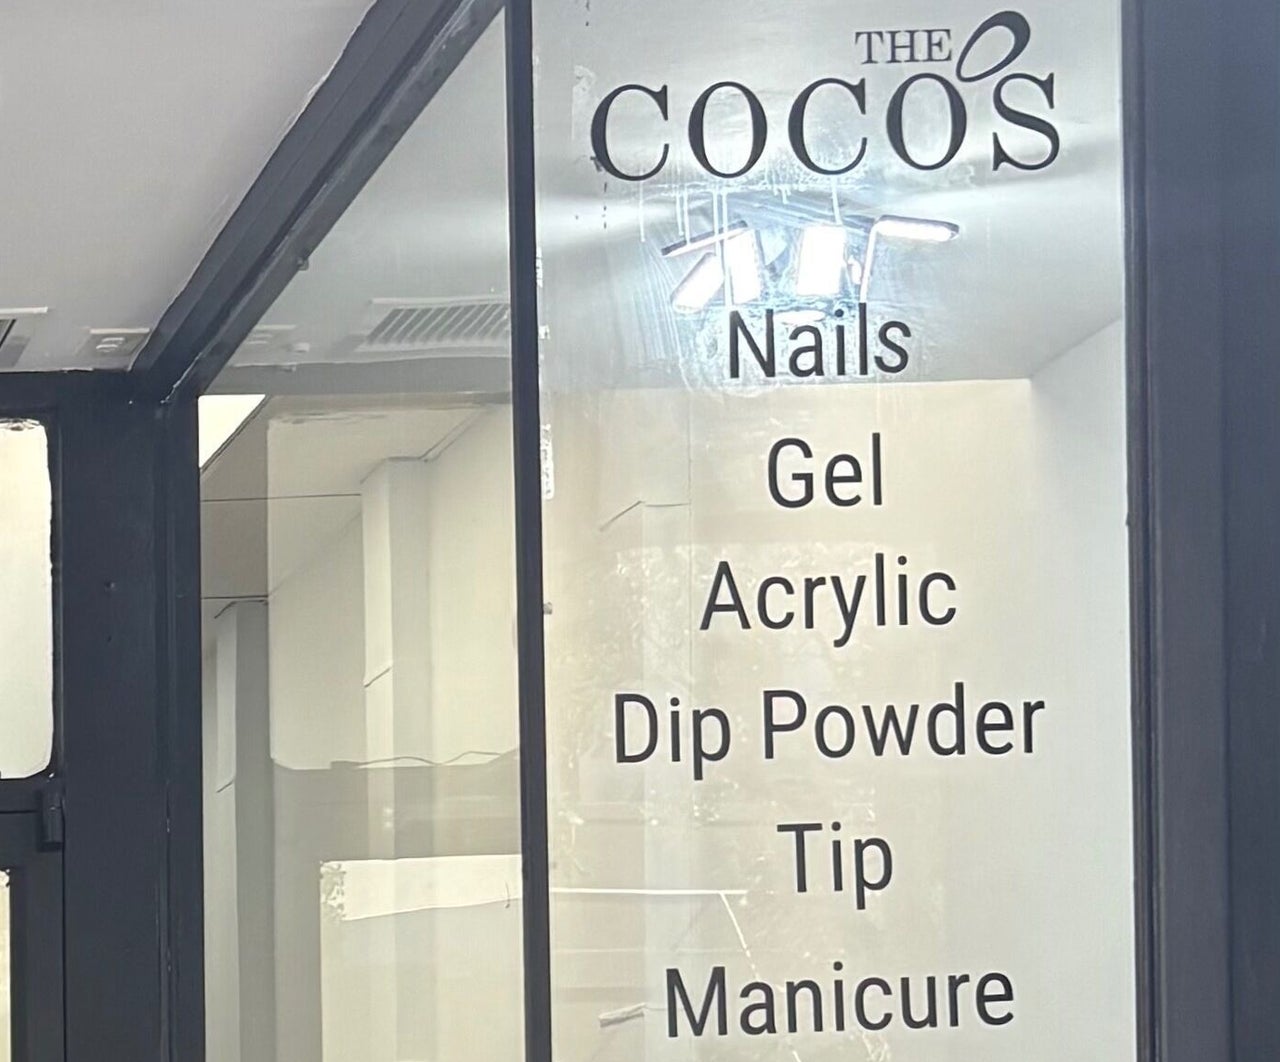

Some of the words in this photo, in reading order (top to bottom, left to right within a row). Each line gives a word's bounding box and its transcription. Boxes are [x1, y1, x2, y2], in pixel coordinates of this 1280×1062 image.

[856, 30, 951, 63] THE
[731, 303, 910, 377] Nails
[769, 433, 881, 507] Gel
[701, 554, 955, 647] Acrylic
[616, 694, 730, 780] Dip
[764, 683, 1044, 758] Powder
[778, 822, 892, 909] Tip
[667, 962, 1013, 1037] Manicure
